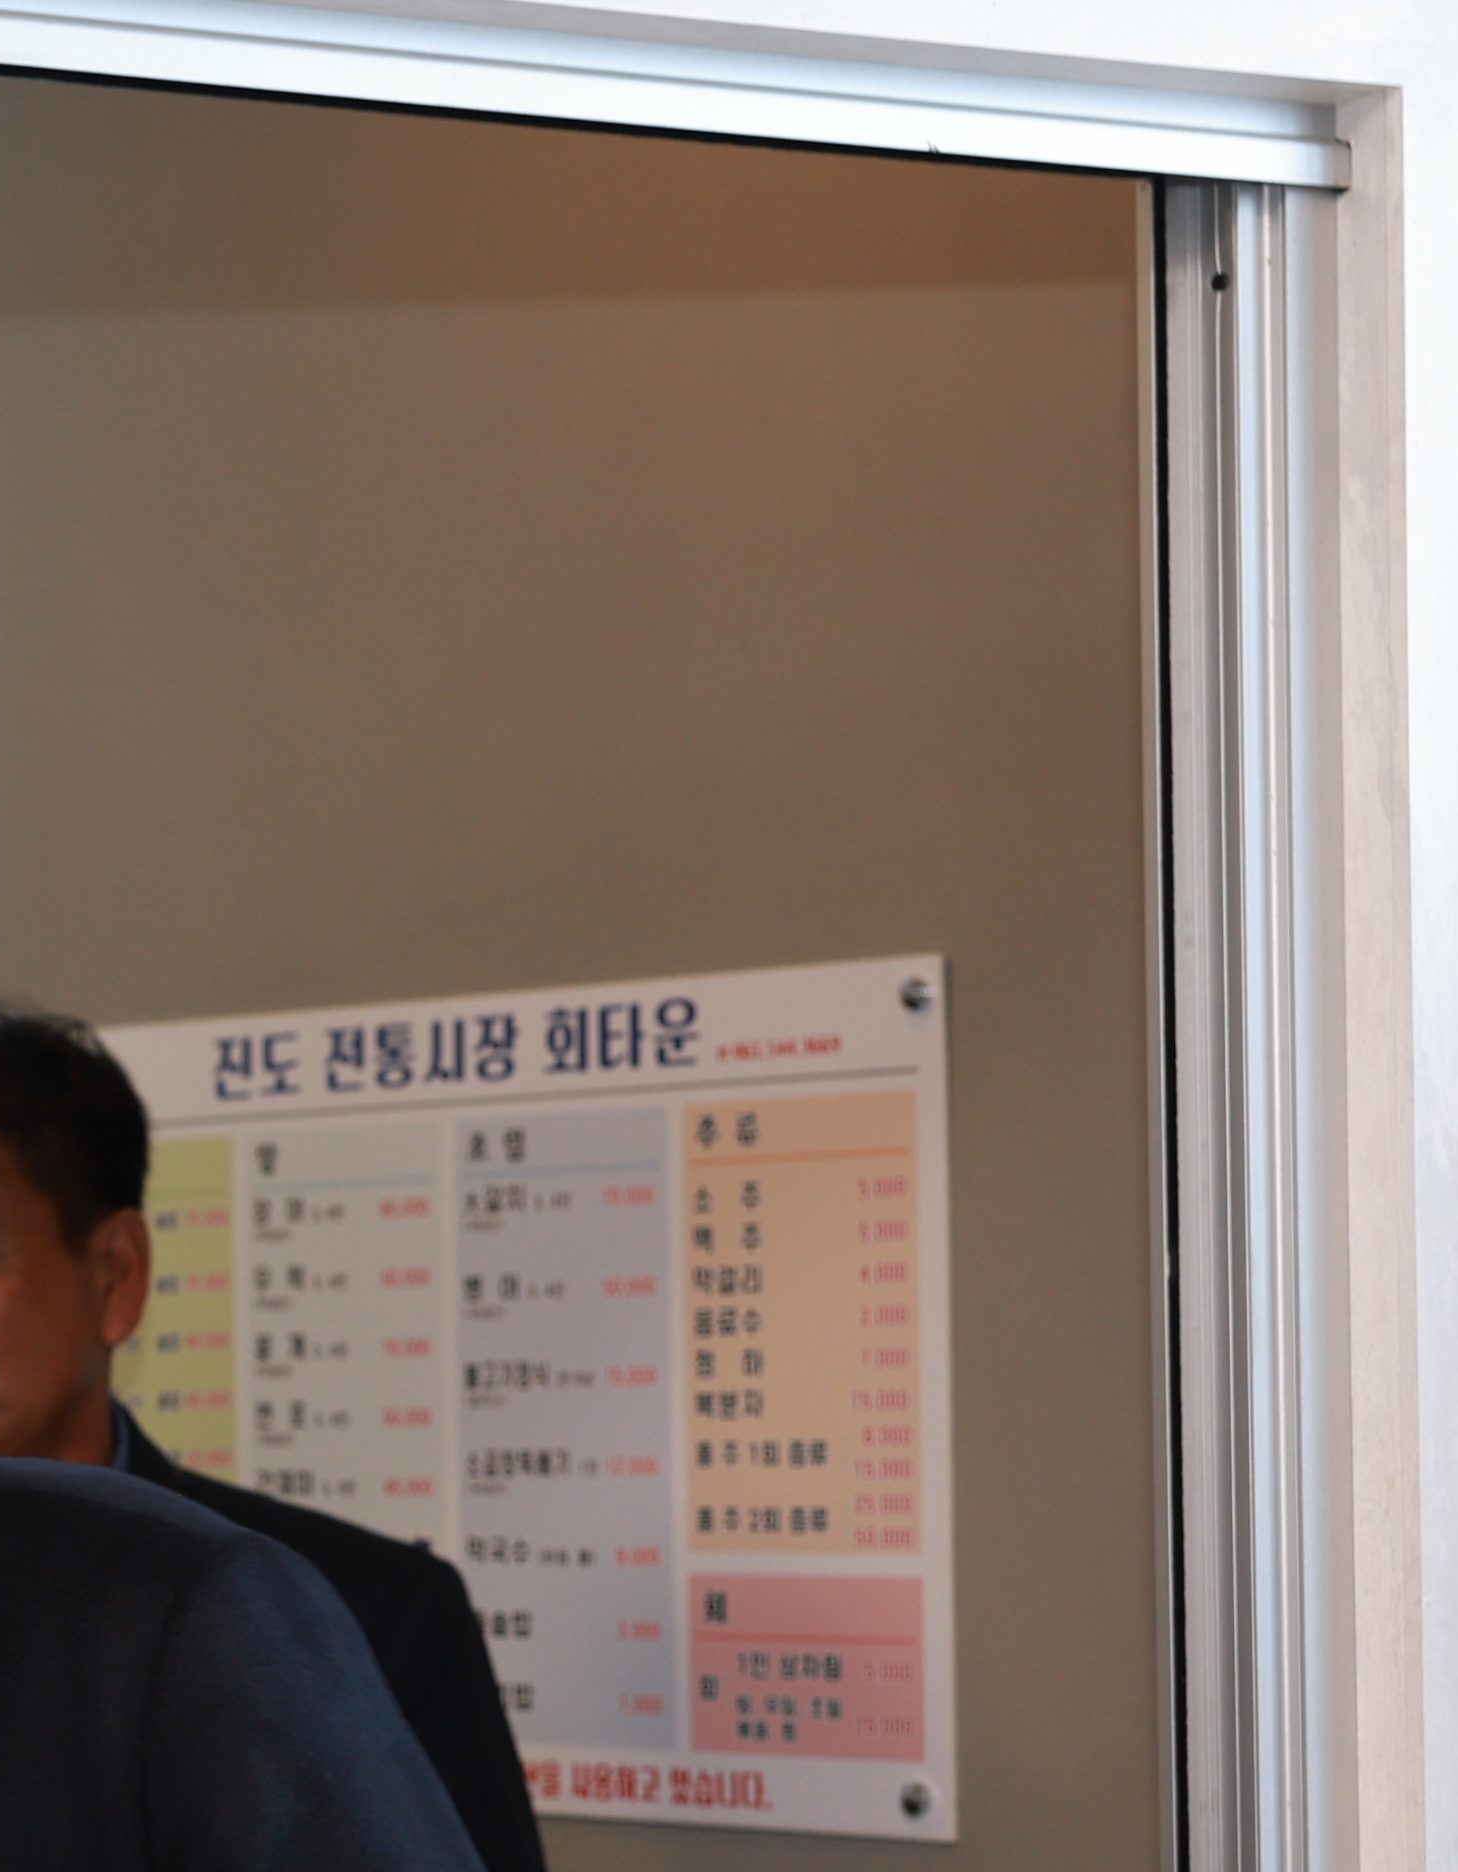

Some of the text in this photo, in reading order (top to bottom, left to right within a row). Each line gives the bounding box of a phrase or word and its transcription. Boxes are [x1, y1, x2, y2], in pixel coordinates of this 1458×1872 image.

[213, 996, 700, 1101] 진도 전통시장 회타운
[694, 1306, 762, 1338] 음료수
[695, 1390, 764, 1420] 복분자
[572, 1760, 661, 1804] 사용하고
[670, 1766, 774, 1811] 있습니다.
